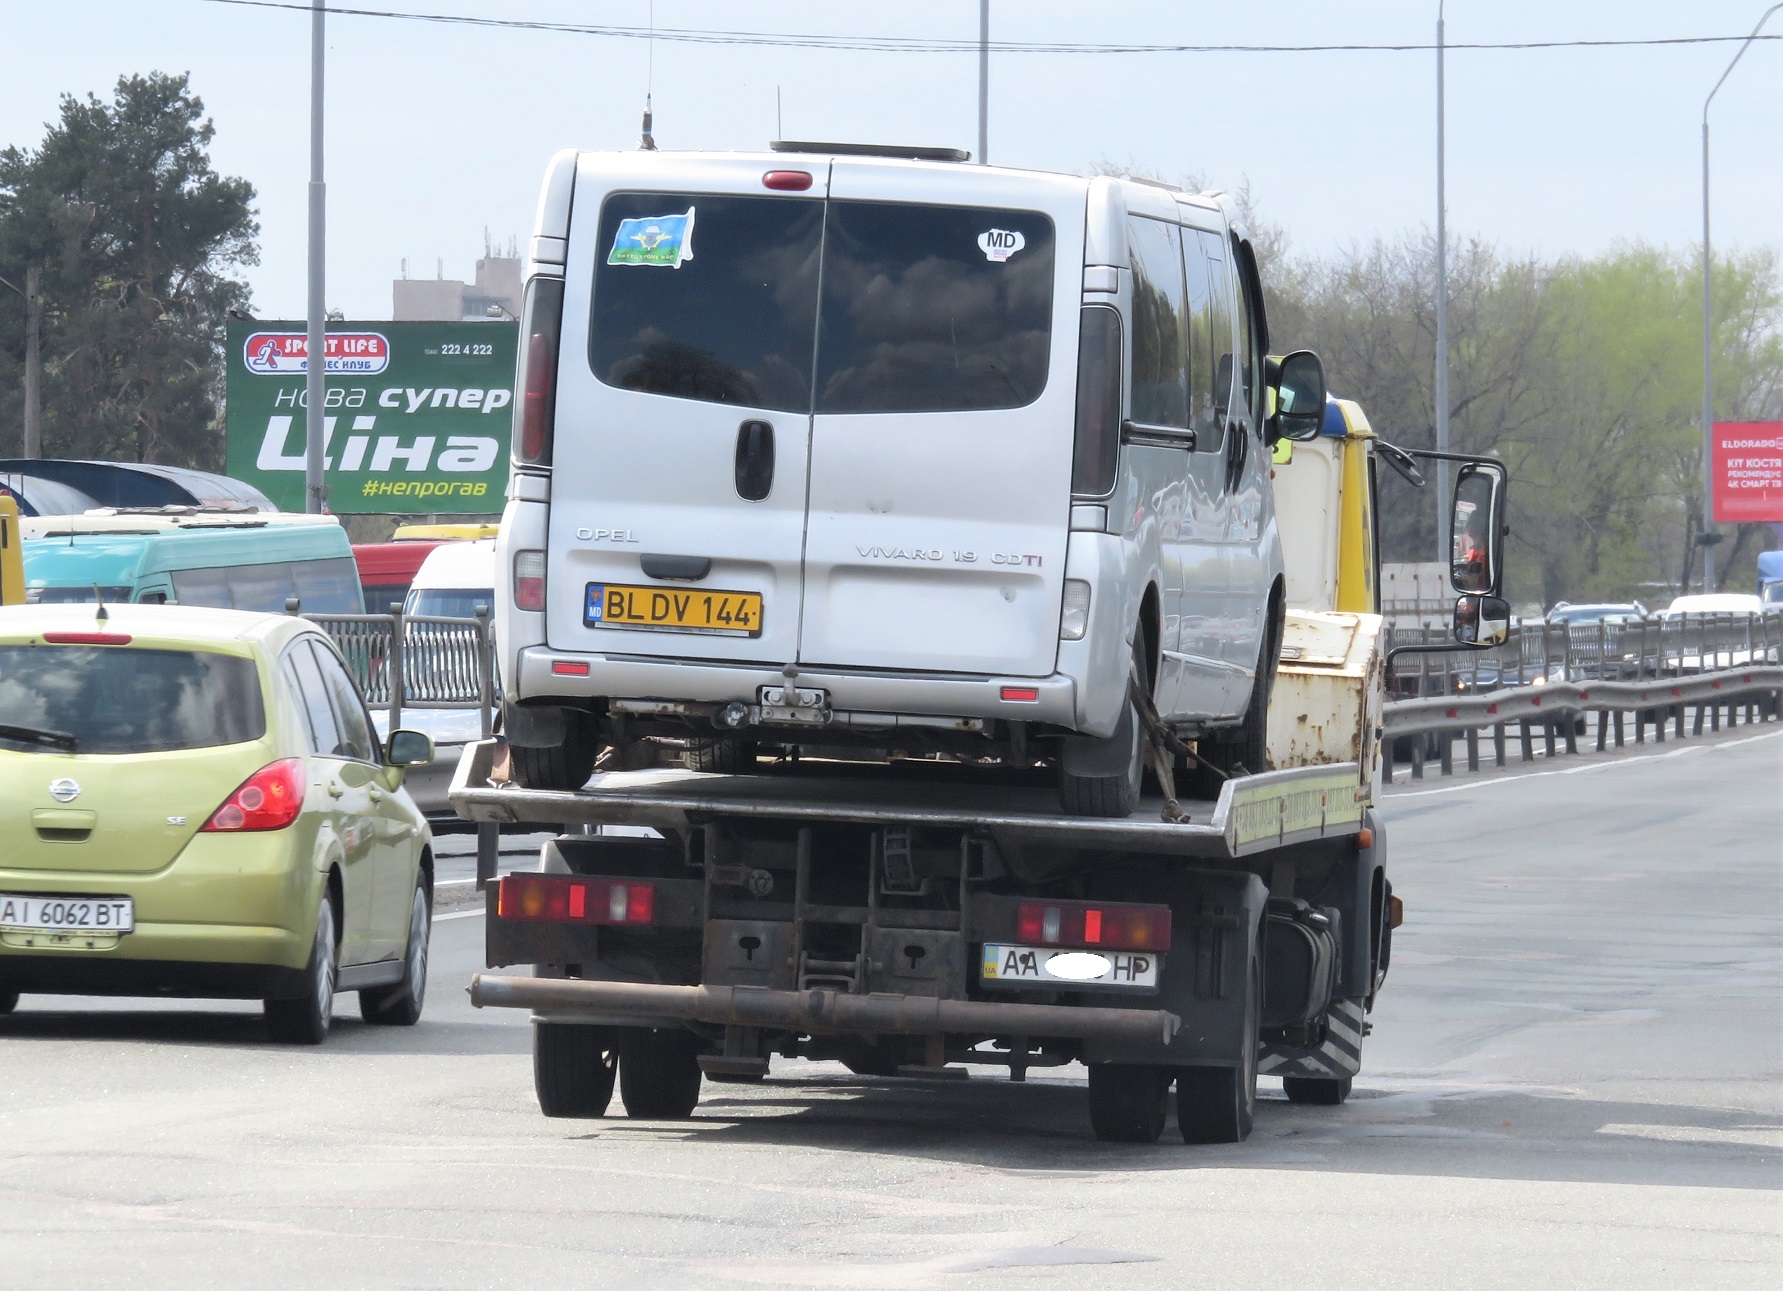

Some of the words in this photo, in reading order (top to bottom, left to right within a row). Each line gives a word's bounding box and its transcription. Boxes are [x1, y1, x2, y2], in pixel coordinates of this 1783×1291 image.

[987, 232, 1016, 248] MD
[343, 339, 378, 353] LIFE
[441, 344, 461, 355] 222
[462, 344, 470, 355] 4
[472, 344, 493, 355] 222
[342, 360, 371, 370] КЛУБ
[379, 388, 512, 413] супер
[256, 415, 499, 471] Ціна
[1722, 440, 1775, 449] ELDORADO
[1746, 458, 1782, 468] КОСТЯ
[362, 480, 488, 499] #непрогав
[576, 527, 640, 543] OPEL
[855, 545, 944, 561] VIVARO
[990, 552, 1043, 568] CDTI
[589, 606, 602, 618] MD
[703, 596, 750, 626] 144
[166, 816, 187, 826] SE
[39, 902, 90, 925] 6062
[95, 903, 126, 926] BT
[985, 966, 996, 975] UA
[1002, 951, 1039, 976] AA
[1113, 956, 1150, 981] HP
